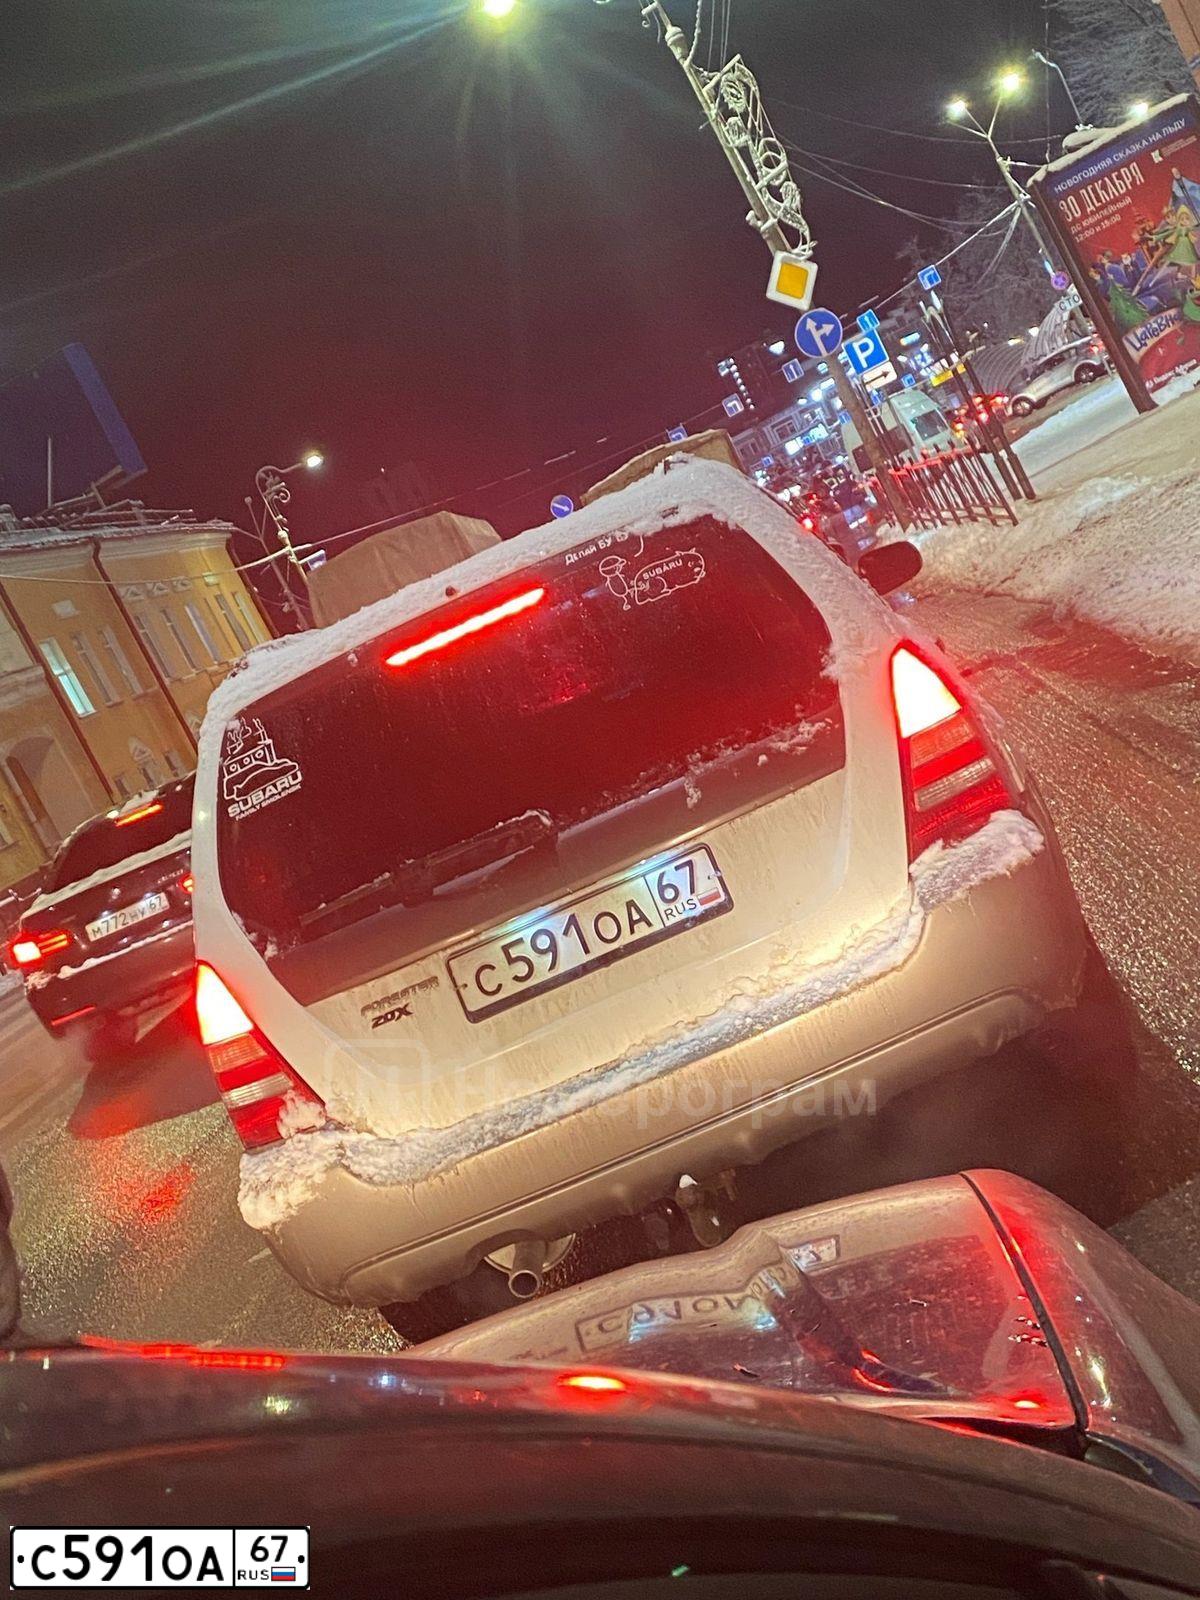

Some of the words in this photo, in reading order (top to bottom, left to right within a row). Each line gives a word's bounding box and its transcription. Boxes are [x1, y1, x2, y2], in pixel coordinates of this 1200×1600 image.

[1054, 157, 1113, 193] НОВОГОДНЯЯ
[1113, 139, 1149, 162] СКАЗКА
[1148, 132, 1163, 142] НА
[1162, 118, 1186, 136] ЛЬДУ
[1059, 195, 1081, 222] 30
[1079, 161, 1144, 215] ДЕКАБРЯ
[642, 559, 683, 580] SUBARU
[227, 770, 303, 818] SUBARU
[149, 896, 163, 911] 67
[656, 859, 697, 904] 67
[664, 898, 698, 921] RUS
